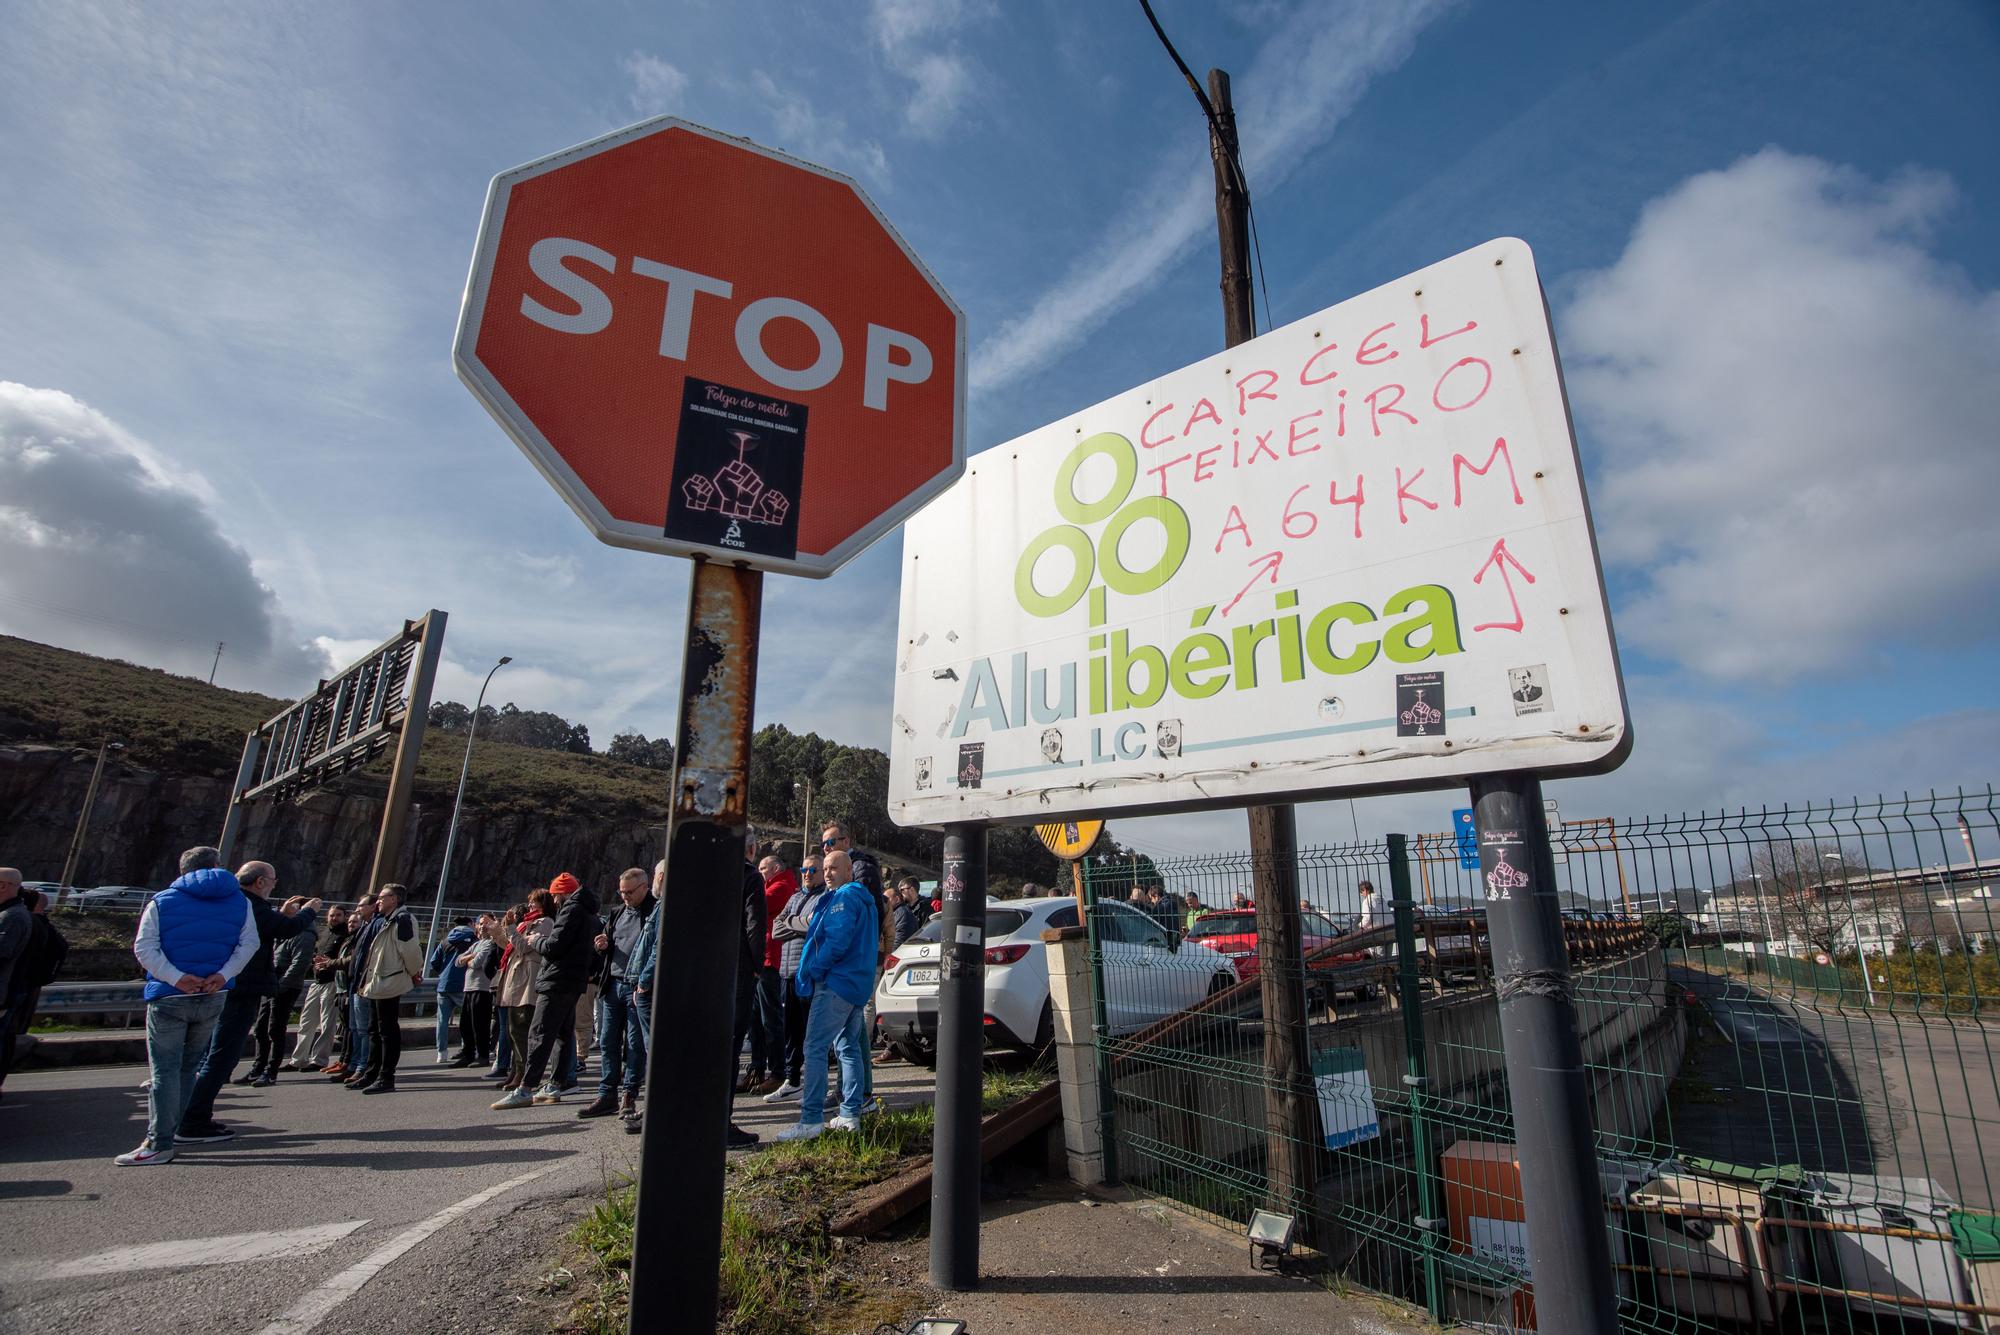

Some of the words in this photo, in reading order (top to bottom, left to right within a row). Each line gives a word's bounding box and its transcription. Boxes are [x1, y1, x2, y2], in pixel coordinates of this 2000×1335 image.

[520, 237, 933, 412] STOP
[1140, 314, 1477, 449] CARCEL
[705, 386, 739, 408] Folga
[740, 397, 757, 409] do
[758, 402, 789, 417] metal
[1147, 357, 1492, 497] TEIXEIRO
[720, 538, 745, 548] PCOE
[1215, 505, 1252, 553] A
[1282, 474, 1365, 539] 64
[1396, 437, 1525, 525] KM
[950, 584, 1467, 738] Aluibérica
[913, 971, 932, 981] 1062
